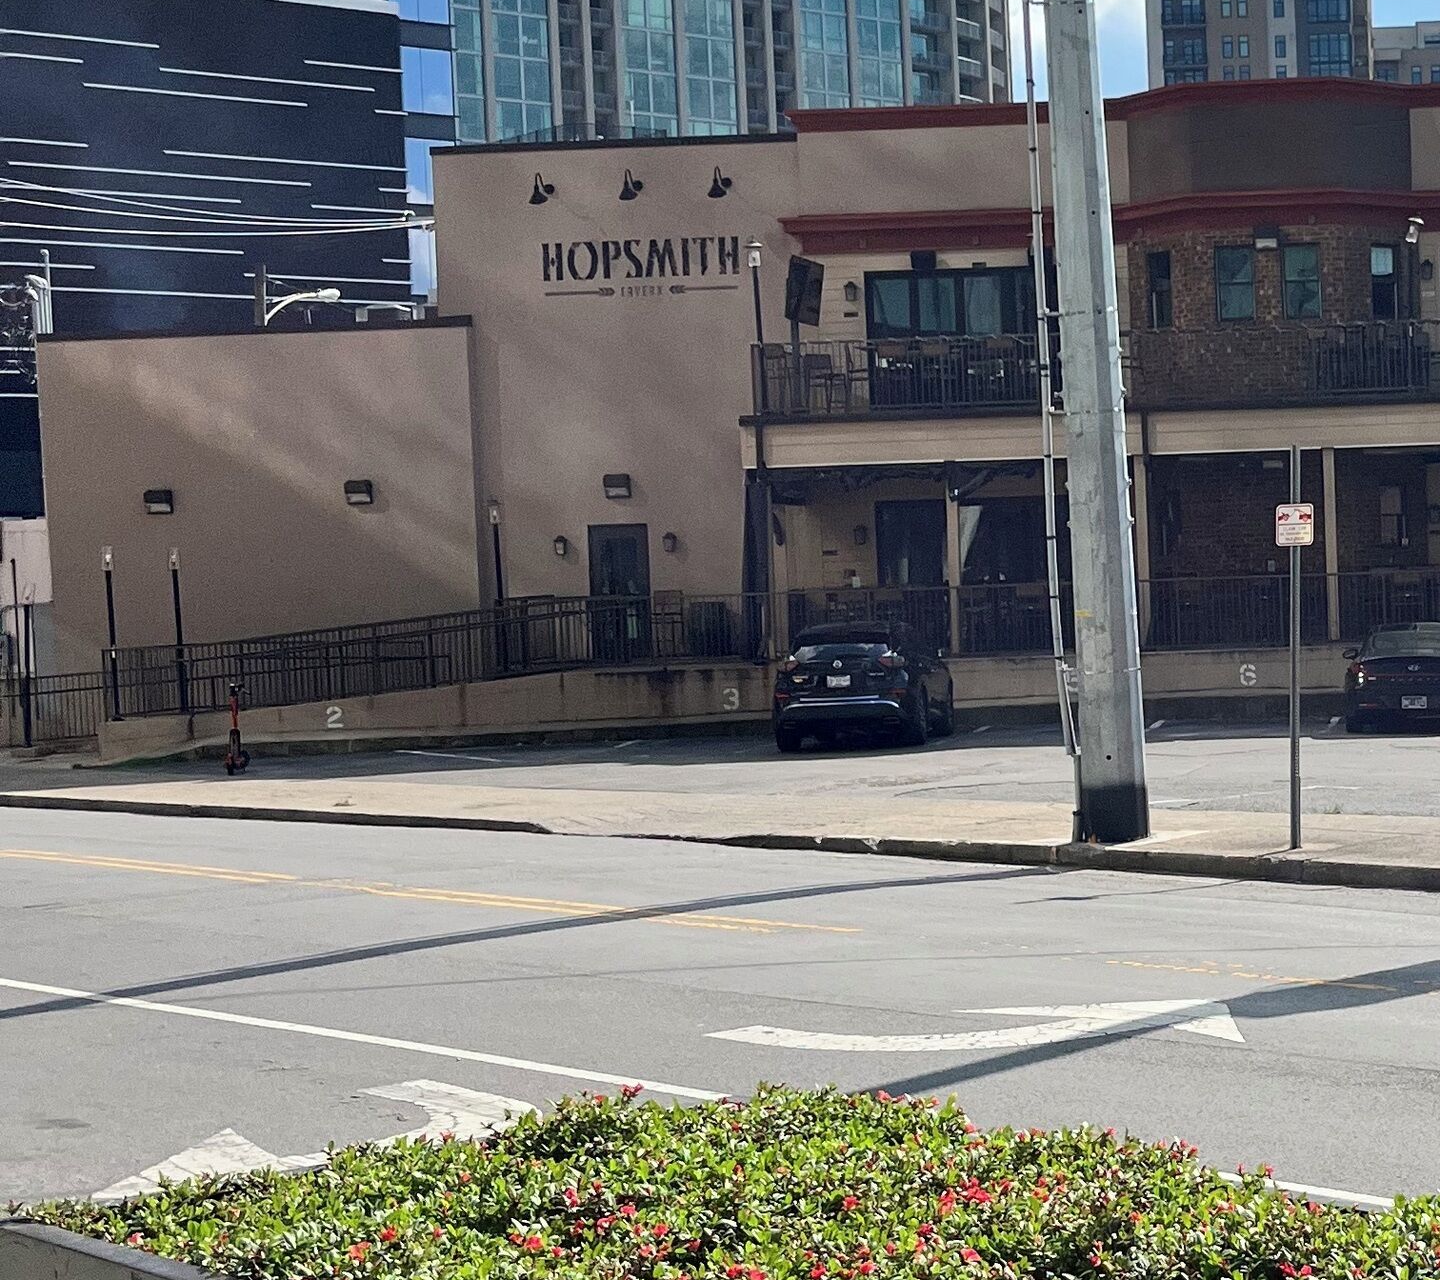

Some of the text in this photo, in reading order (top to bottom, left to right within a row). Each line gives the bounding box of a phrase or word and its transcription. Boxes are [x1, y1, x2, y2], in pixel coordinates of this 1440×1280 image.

[541, 236, 740, 282] HOPSMITH
[1240, 663, 1257, 686] 6
[723, 688, 740, 710] 3
[326, 706, 344, 728] 2
